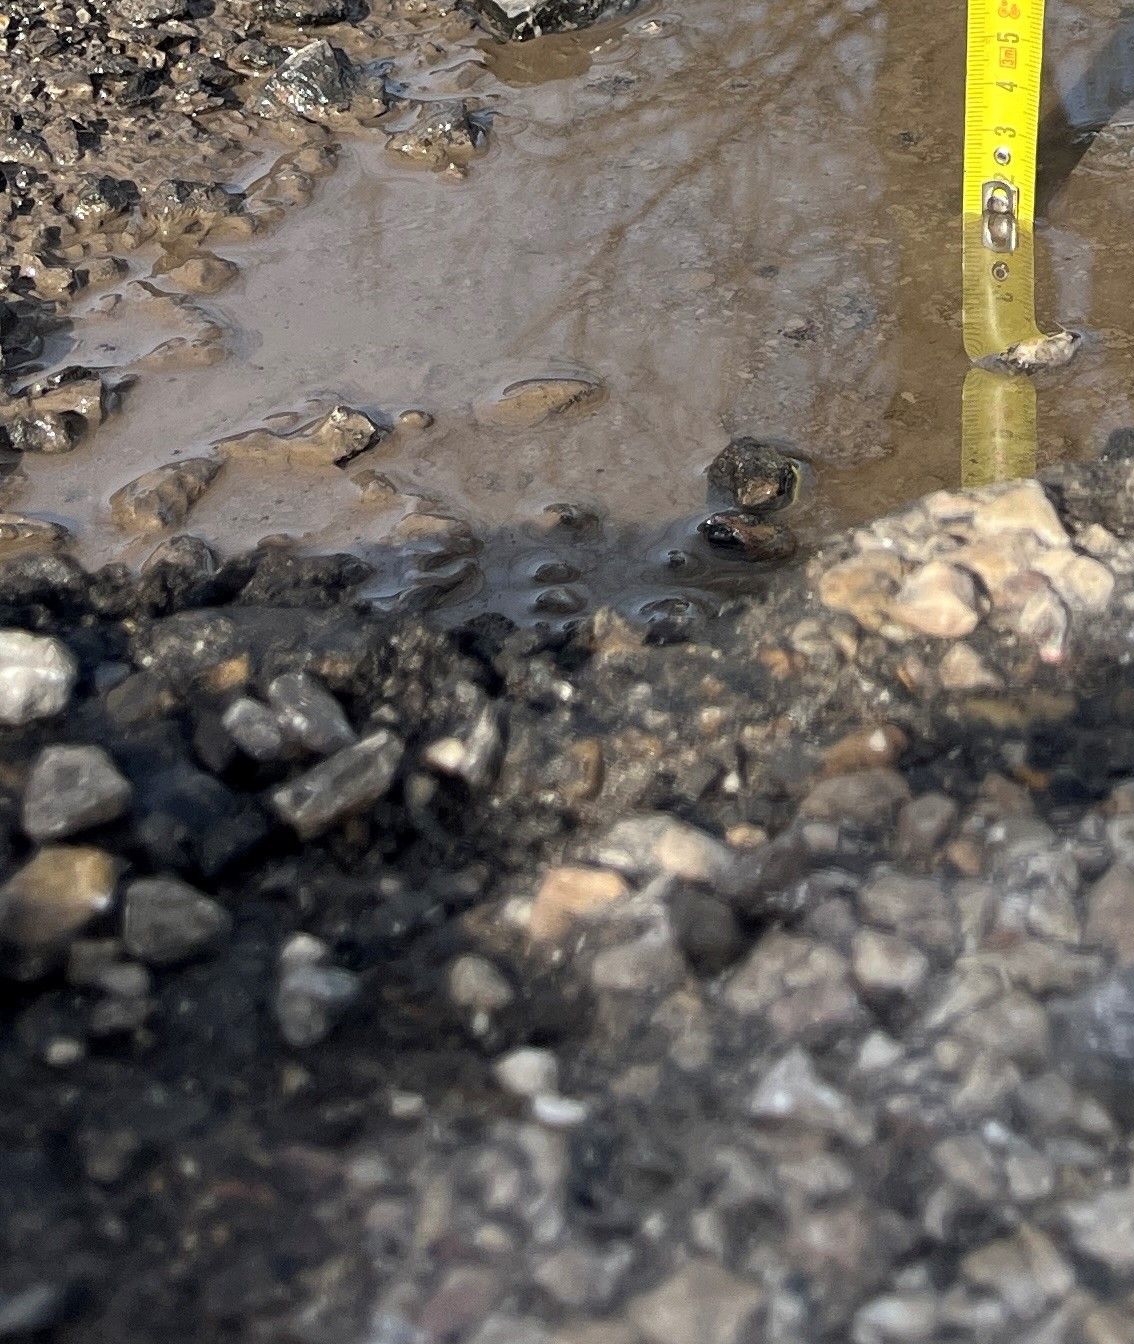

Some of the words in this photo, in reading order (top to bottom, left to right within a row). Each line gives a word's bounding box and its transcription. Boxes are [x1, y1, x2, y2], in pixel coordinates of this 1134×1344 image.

[996, 32, 1020, 44] 5
[1001, 48, 1015, 67] 3m
[995, 81, 1018, 93] 4
[993, 125, 1017, 139] 3
